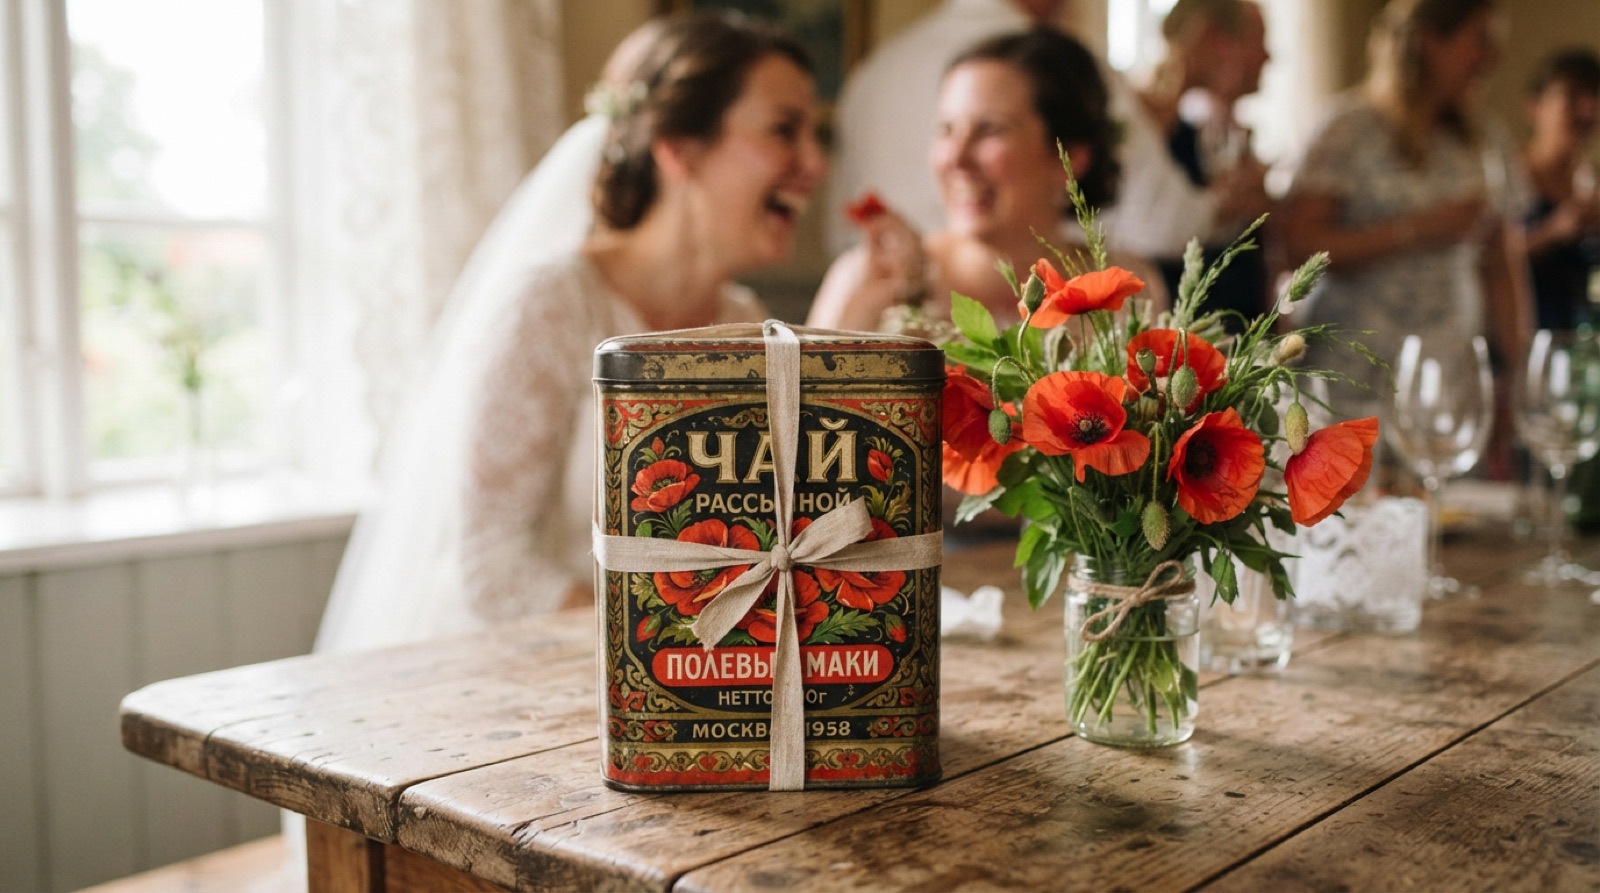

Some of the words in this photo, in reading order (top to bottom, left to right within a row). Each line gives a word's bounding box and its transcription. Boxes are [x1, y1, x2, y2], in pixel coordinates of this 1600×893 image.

[695, 487, 851, 514] РАССЫНОЙ
[666, 652, 776, 680] ПОЛЕВЫ
[806, 650, 879, 677] МАКИ
[718, 690, 774, 706] НЕТТО
[692, 722, 772, 739] МОСКВ
